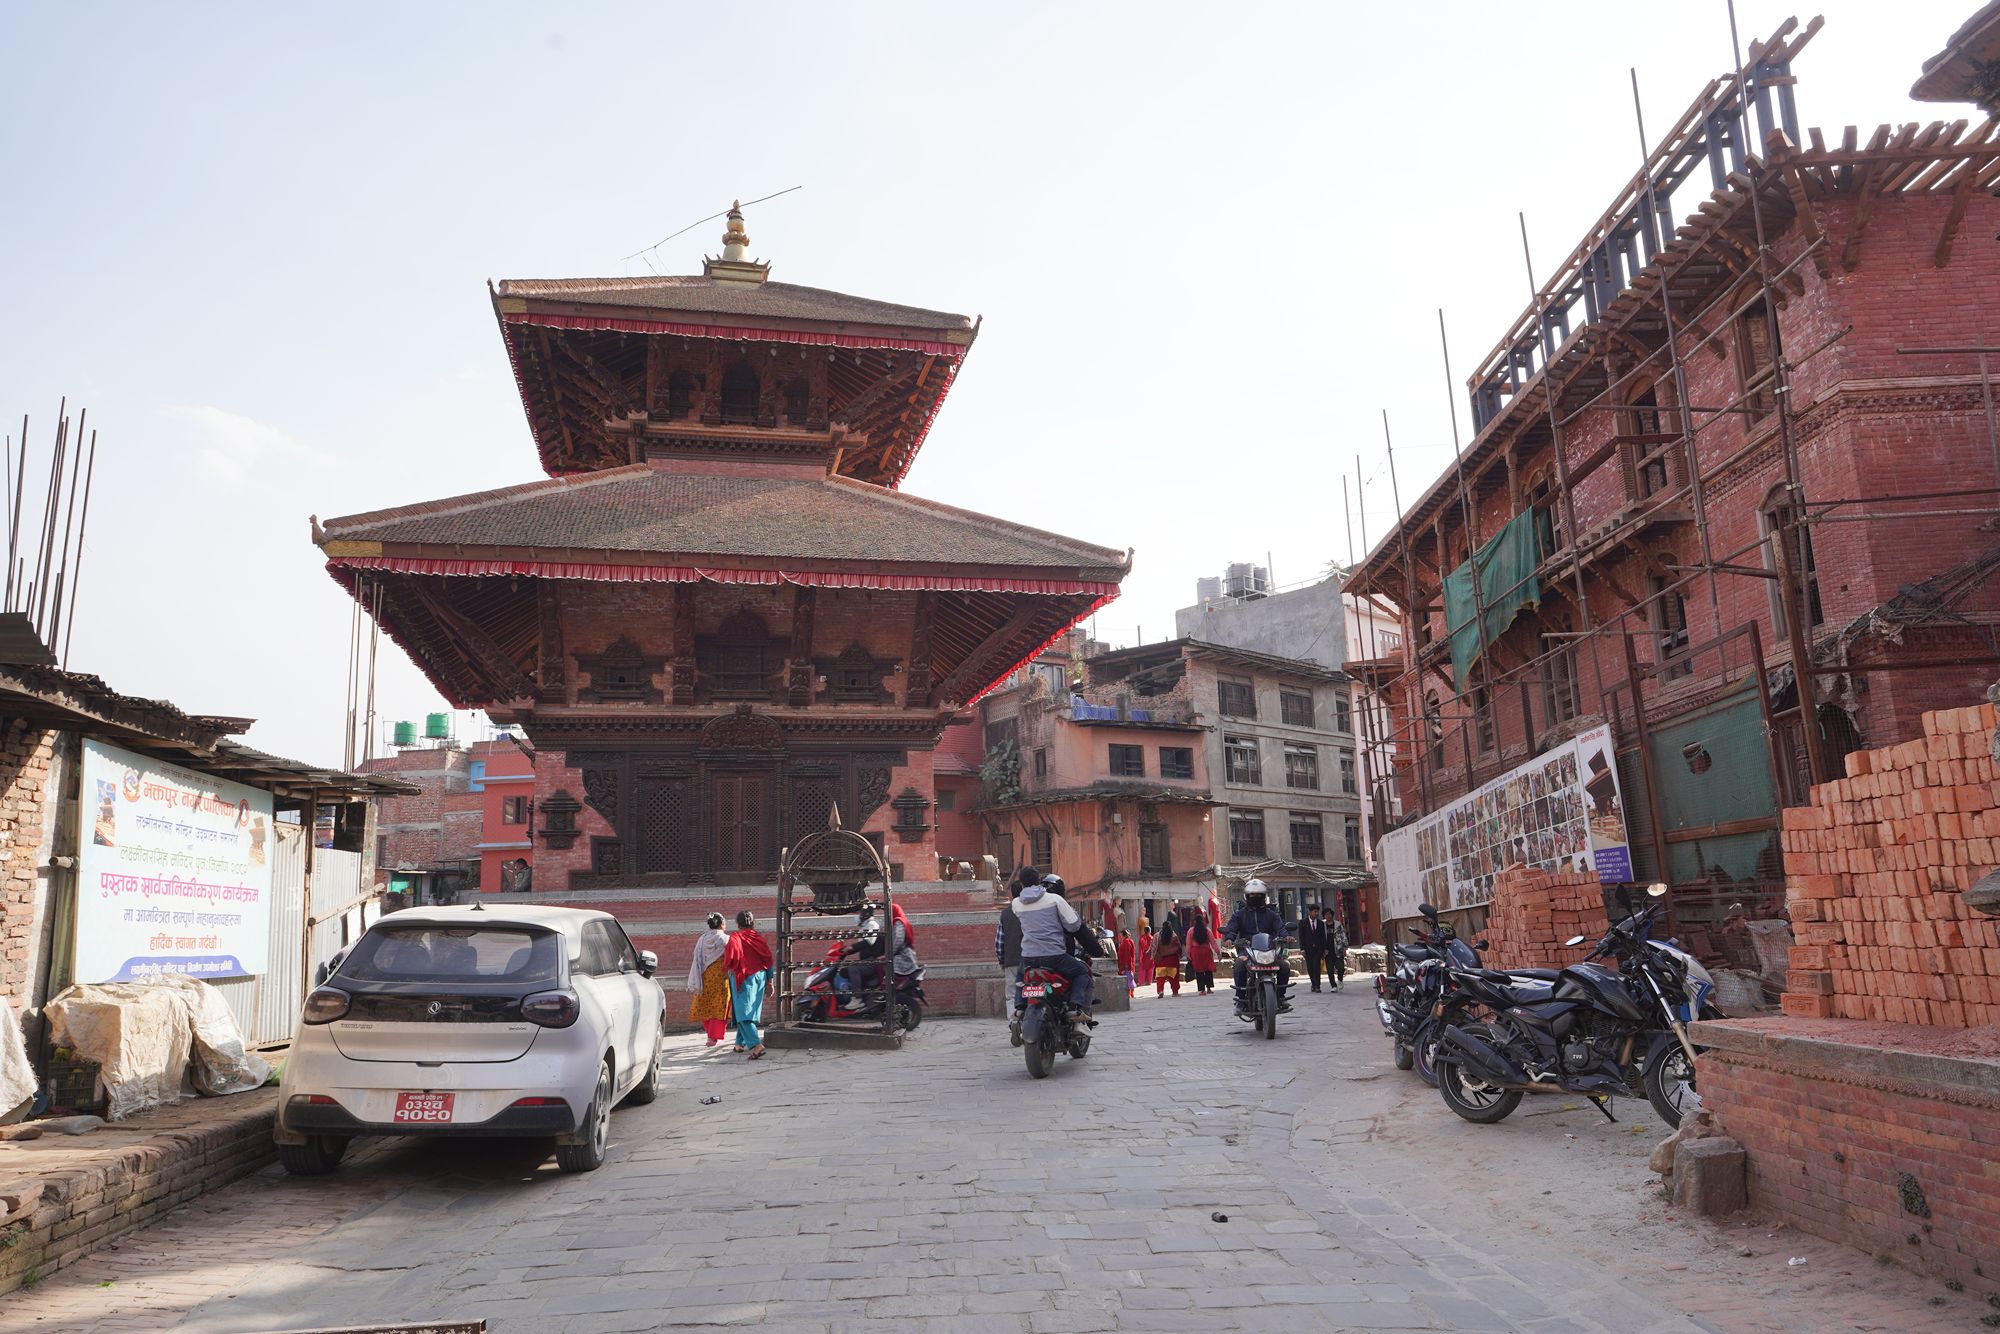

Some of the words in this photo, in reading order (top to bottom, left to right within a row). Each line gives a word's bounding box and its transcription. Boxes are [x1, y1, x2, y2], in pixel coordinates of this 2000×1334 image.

[144, 782, 179, 808] भक्तपुर
[181, 792, 235, 817] नगरपालिका
[101, 872, 139, 898] पुस्तक
[140, 873, 222, 906] सार्वजनिकीकरण
[223, 882, 259, 903] कार्यक्रम
[123, 909, 134, 922] मा
[135, 906, 171, 925] आमन्त्रित
[172, 909, 194, 928] सम्पूर्ण
[149, 932, 173, 951] हार्दिक
[175, 937, 197, 951] स्वागत
